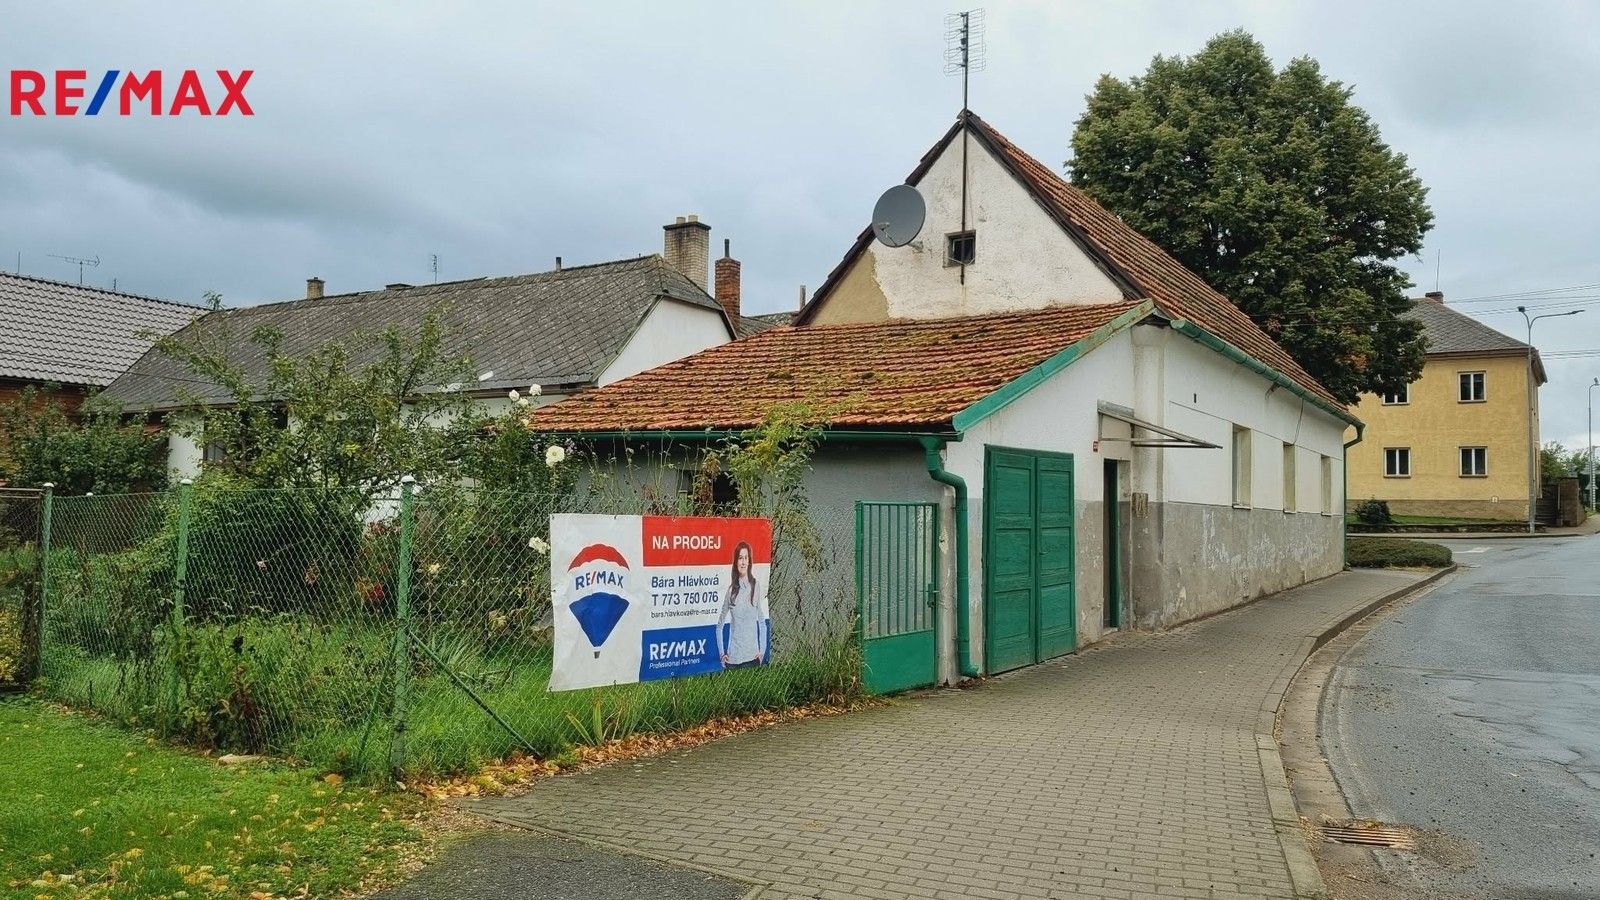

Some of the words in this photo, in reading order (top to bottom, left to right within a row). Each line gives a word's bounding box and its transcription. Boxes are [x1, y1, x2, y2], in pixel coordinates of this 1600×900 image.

[652, 535, 669, 550] NA
[673, 535, 721, 550] PRODEJ
[575, 571, 624, 590] RE/MAX
[651, 576, 675, 588] Bára
[678, 574, 719, 587] Hlávková
[652, 594, 659, 606] T
[662, 593, 680, 606] 773
[683, 592, 700, 604] 750
[702, 591, 719, 603] 076
[649, 639, 706, 660] RE/MAX
[649, 660, 681, 669] Professional
[681, 658, 700, 666] Partners
